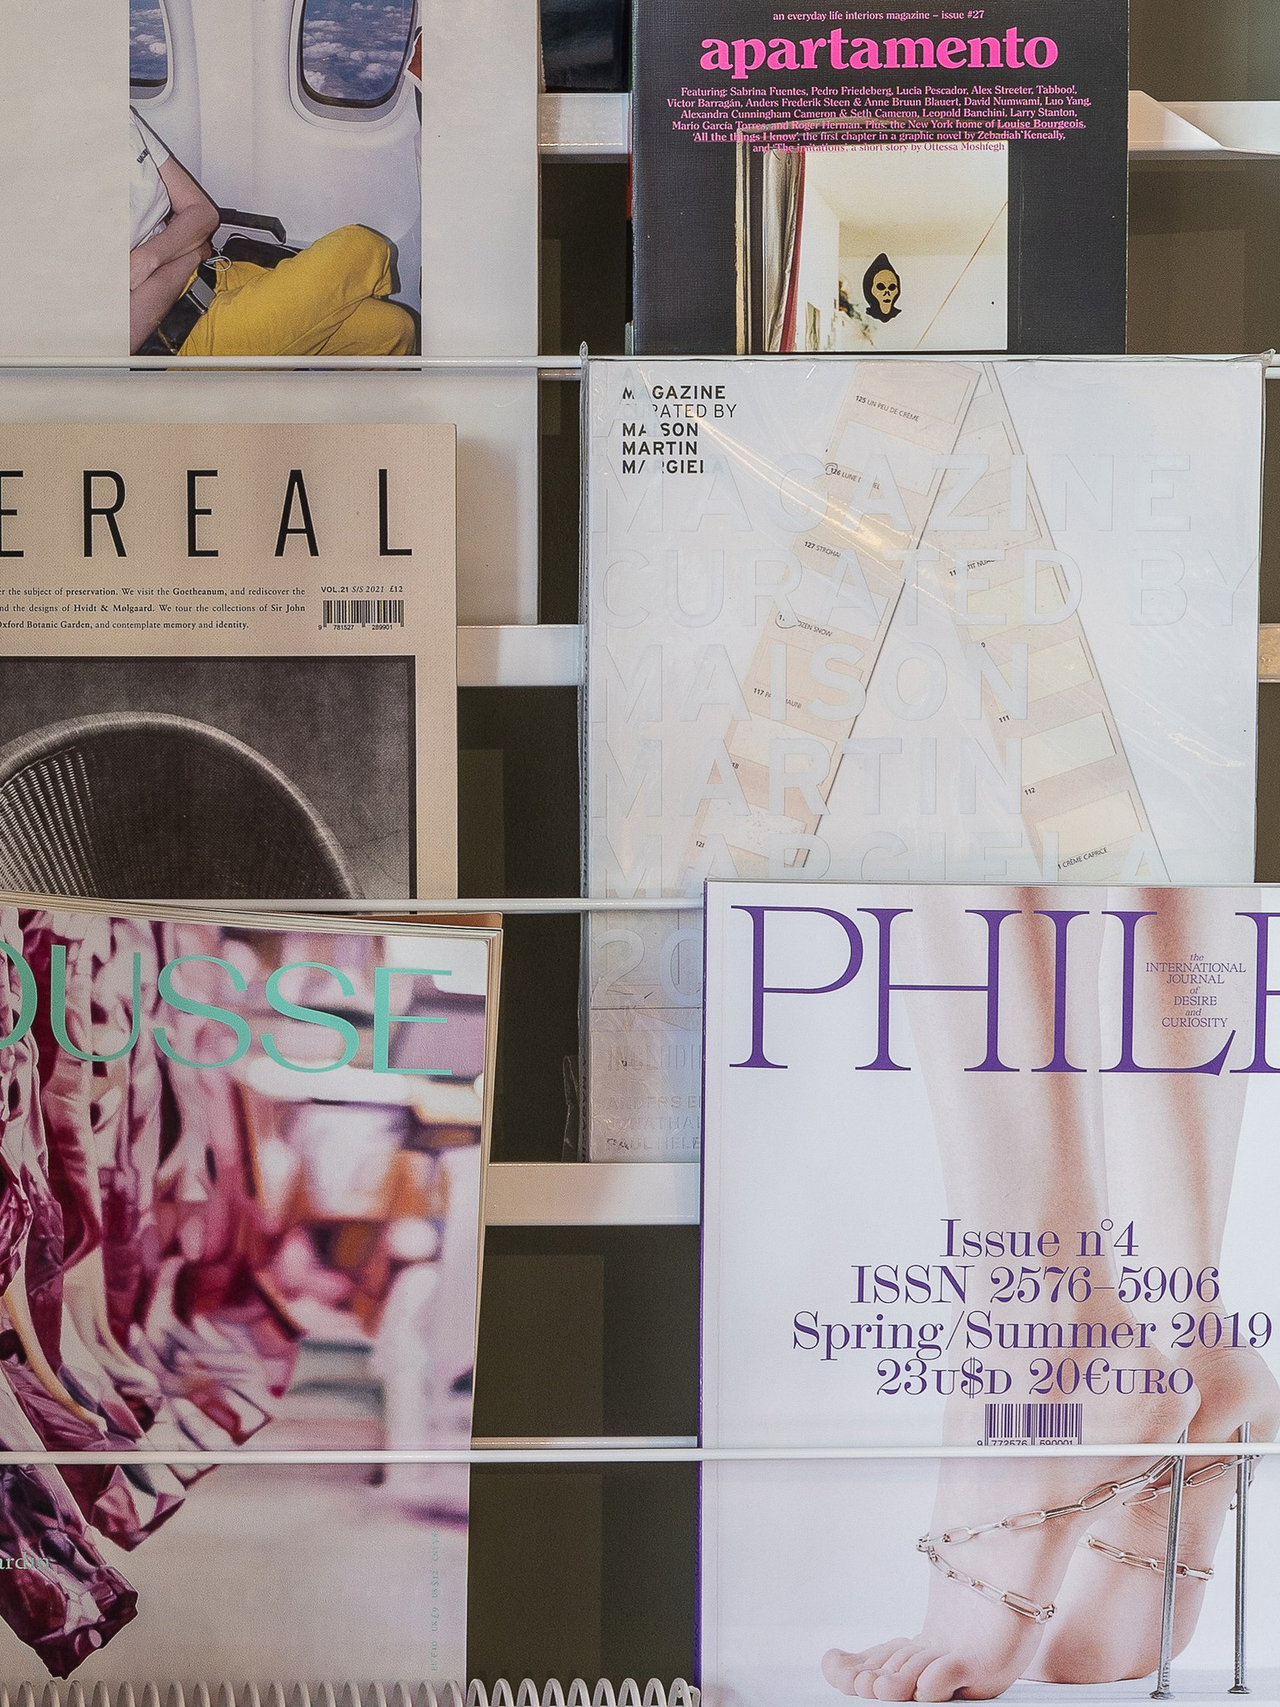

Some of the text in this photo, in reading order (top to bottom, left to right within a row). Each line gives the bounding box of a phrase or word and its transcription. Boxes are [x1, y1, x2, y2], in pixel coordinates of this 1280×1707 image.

[787, 11, 827, 21] everyday
[829, 11, 843, 20] life
[845, 11, 884, 20] interiors
[886, 11, 930, 21] magazine
[941, 10, 964, 19] issue
[967, 10, 985, 19] #27
[699, 25, 1059, 80] apartamento
[681, 87, 727, 97] Featuring:
[730, 87, 766, 96] Sabrina
[769, 87, 809, 97] Fuentes,
[811, 87, 838, 96] Pedro
[896, 86, 922, 95] Lucia
[924, 86, 968, 96] Pescador,
[971, 86, 992, 95] Alex
[994, 85, 1034, 96] Streeter,
[1036, 85, 1078, 95] Tabboo!,
[622, 385, 726, 400] MGAZINE
[714, 404, 737, 418] BY
[622, 422, 699, 437] MASON
[622, 441, 698, 456] MARTIN
[8, 587, 21, 595] the
[23, 587, 52, 597] subject
[54, 587, 64, 595] of
[66, 587, 119, 597] preservation.
[121, 588, 135, 596] We
[137, 587, 155, 596] visit
[157, 587, 170, 596] the
[172, 587, 228, 597] Goetheanum,
[230, 587, 246, 596] and
[248, 587, 290, 596] rediscover
[292, 587, 306, 596] the
[351, 585, 364, 593] S/S
[365, 585, 384, 593] 2021
[389, 585, 403, 593] £12
[1190, 953, 1205, 962] the
[1146, 962, 1247, 973] INTERNATIONAL
[1166, 974, 1225, 984] JOURNAL
[1190, 986, 1201, 995] of
[1174, 996, 1218, 1006] DESIRE
[1185, 1008, 1202, 1017] and
[1161, 1017, 1228, 1028] CURIOSITY
[940, 1218, 1061, 1259] Issue
[850, 1264, 1221, 1306] ISSN 2576-5906
[793, 1310, 1272, 1362] Spring/Summer 2019
